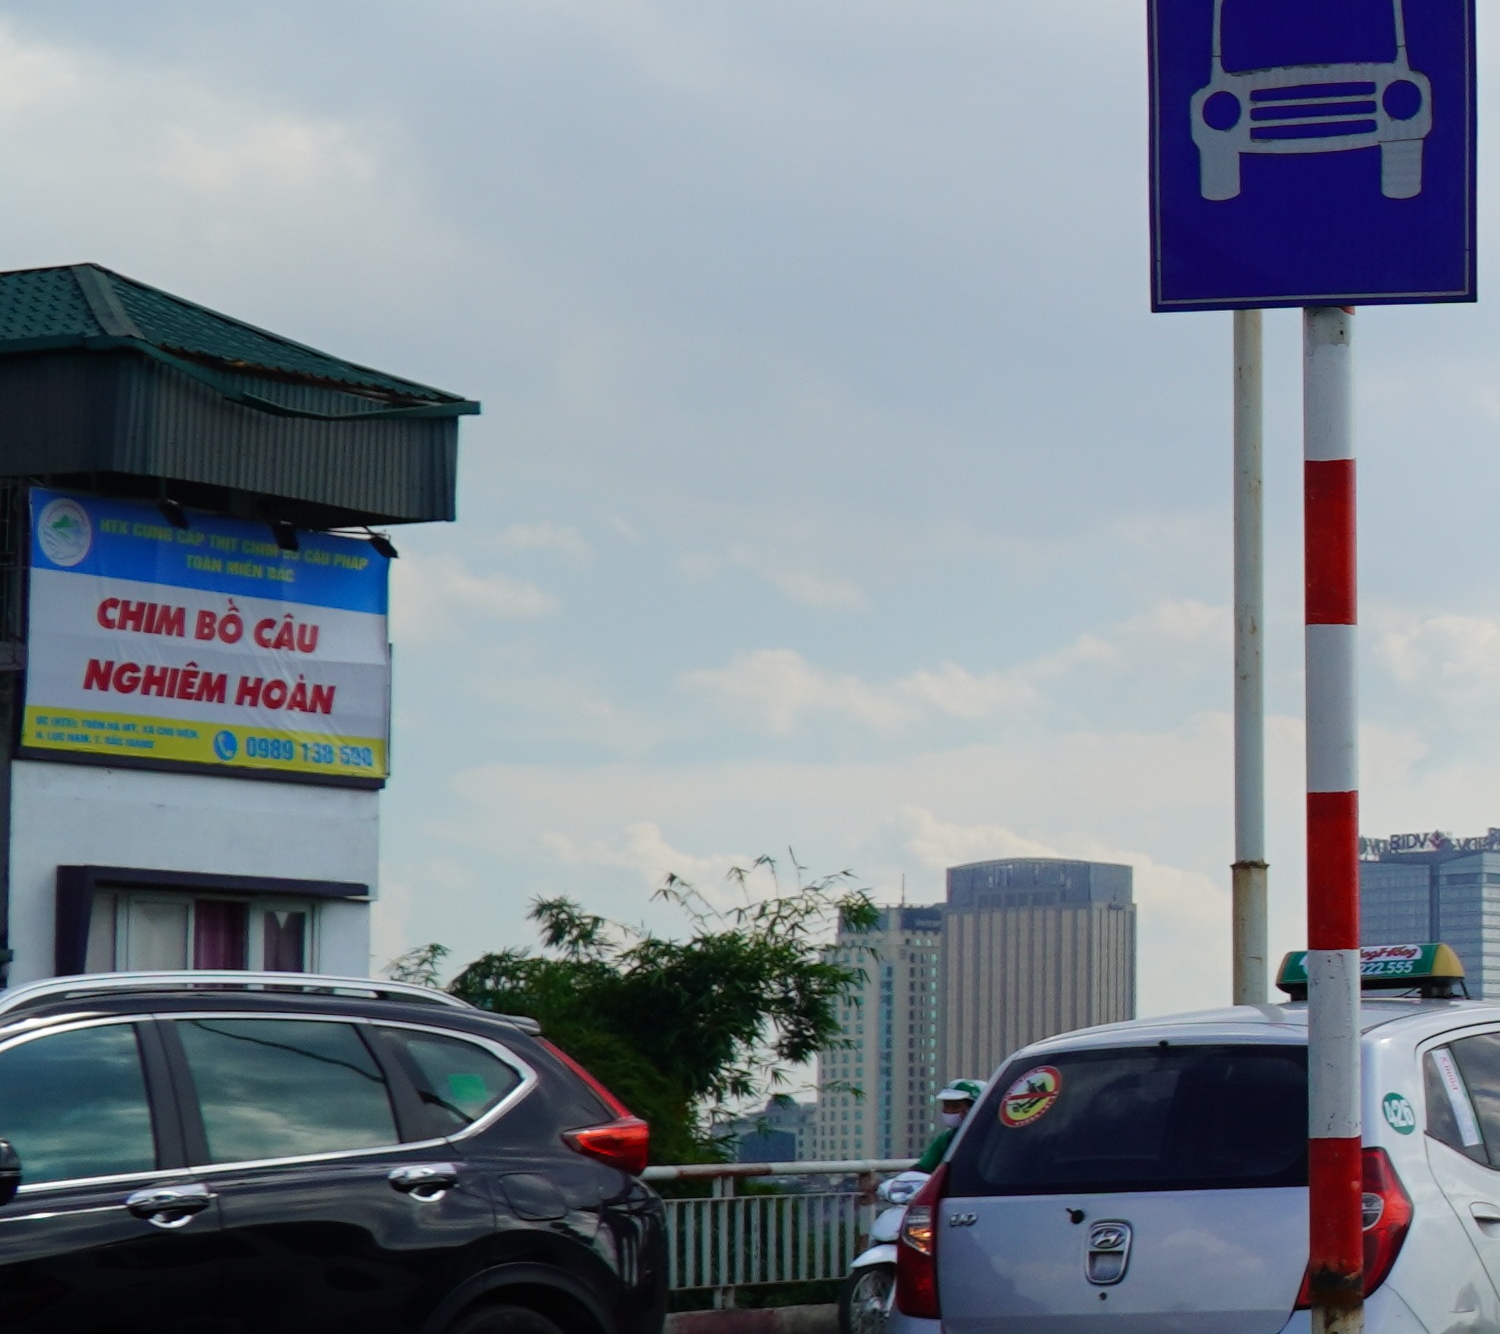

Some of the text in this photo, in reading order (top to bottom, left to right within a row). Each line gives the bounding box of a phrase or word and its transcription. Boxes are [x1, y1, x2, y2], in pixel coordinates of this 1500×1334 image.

[97, 597, 319, 653] CHIM BỒ CÂU
[83, 659, 227, 704] NGHIÊM
[246, 736, 295, 762] 0989
[1390, 833, 1430, 851] BIDV
